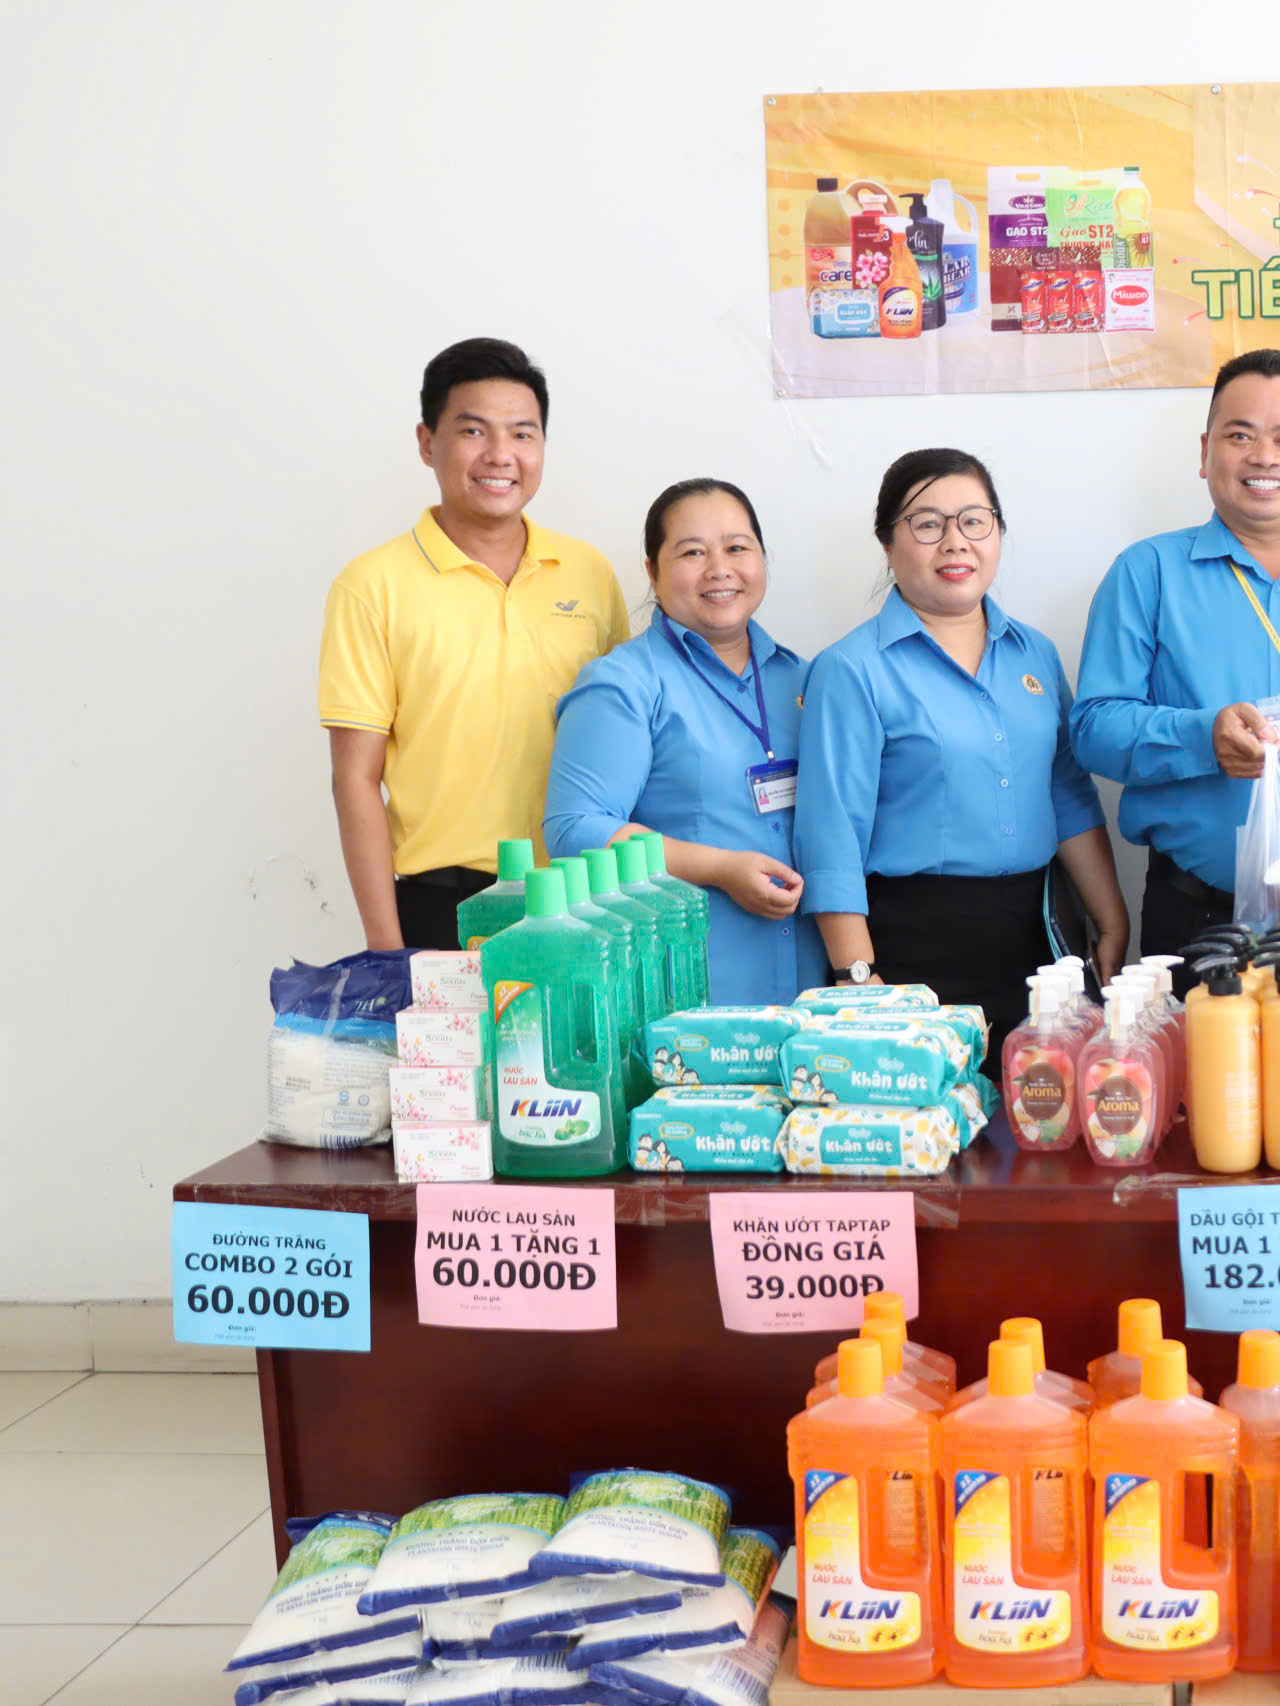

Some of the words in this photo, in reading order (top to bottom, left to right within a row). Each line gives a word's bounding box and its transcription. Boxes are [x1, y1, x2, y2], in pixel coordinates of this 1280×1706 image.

[1030, 226, 1048, 237] ST2
[1088, 224, 1114, 238] ST2
[1112, 289, 1149, 300] Miwon
[711, 1046, 749, 1062] Khăn
[851, 1070, 891, 1088] Khăn
[896, 1072, 928, 1089] ướt
[1023, 1085, 1062, 1097] Aroma
[1098, 1099, 1140, 1111] Aroma
[696, 1134, 736, 1152] Khăn
[740, 1135, 770, 1152] ướt
[825, 1138, 863, 1153] Khăn
[866, 1138, 893, 1153] ướt
[452, 1206, 501, 1223] NƯỚC
[506, 1212, 537, 1225] LAU
[543, 1210, 576, 1227] SÀN
[733, 1216, 779, 1233] KHĂN
[785, 1216, 821, 1233] ƯỚT
[826, 1219, 891, 1233] TAPTAP
[1190, 1209, 1226, 1226] DẦU
[1232, 1208, 1264, 1229] GỘI
[212, 1231, 270, 1248] ĐƯỜNG
[427, 1231, 481, 1251] MUA
[490, 1234, 503, 1251] 1
[511, 1228, 578, 1258] TẶNG
[588, 1238, 601, 1256] 1
[742, 1235, 823, 1262] ĐỒNG
[833, 1234, 885, 1261] GIÁ
[1192, 1236, 1249, 1255] MUA
[1259, 1236, 1272, 1254] 1
[185, 1252, 275, 1275] COMBO
[284, 1257, 298, 1275] 2
[306, 1252, 353, 1278] GÓI
[433, 1257, 596, 1290] 60.000Đ
[746, 1274, 884, 1299] 39.000Đ
[187, 1284, 350, 1319] 60.000Đ
